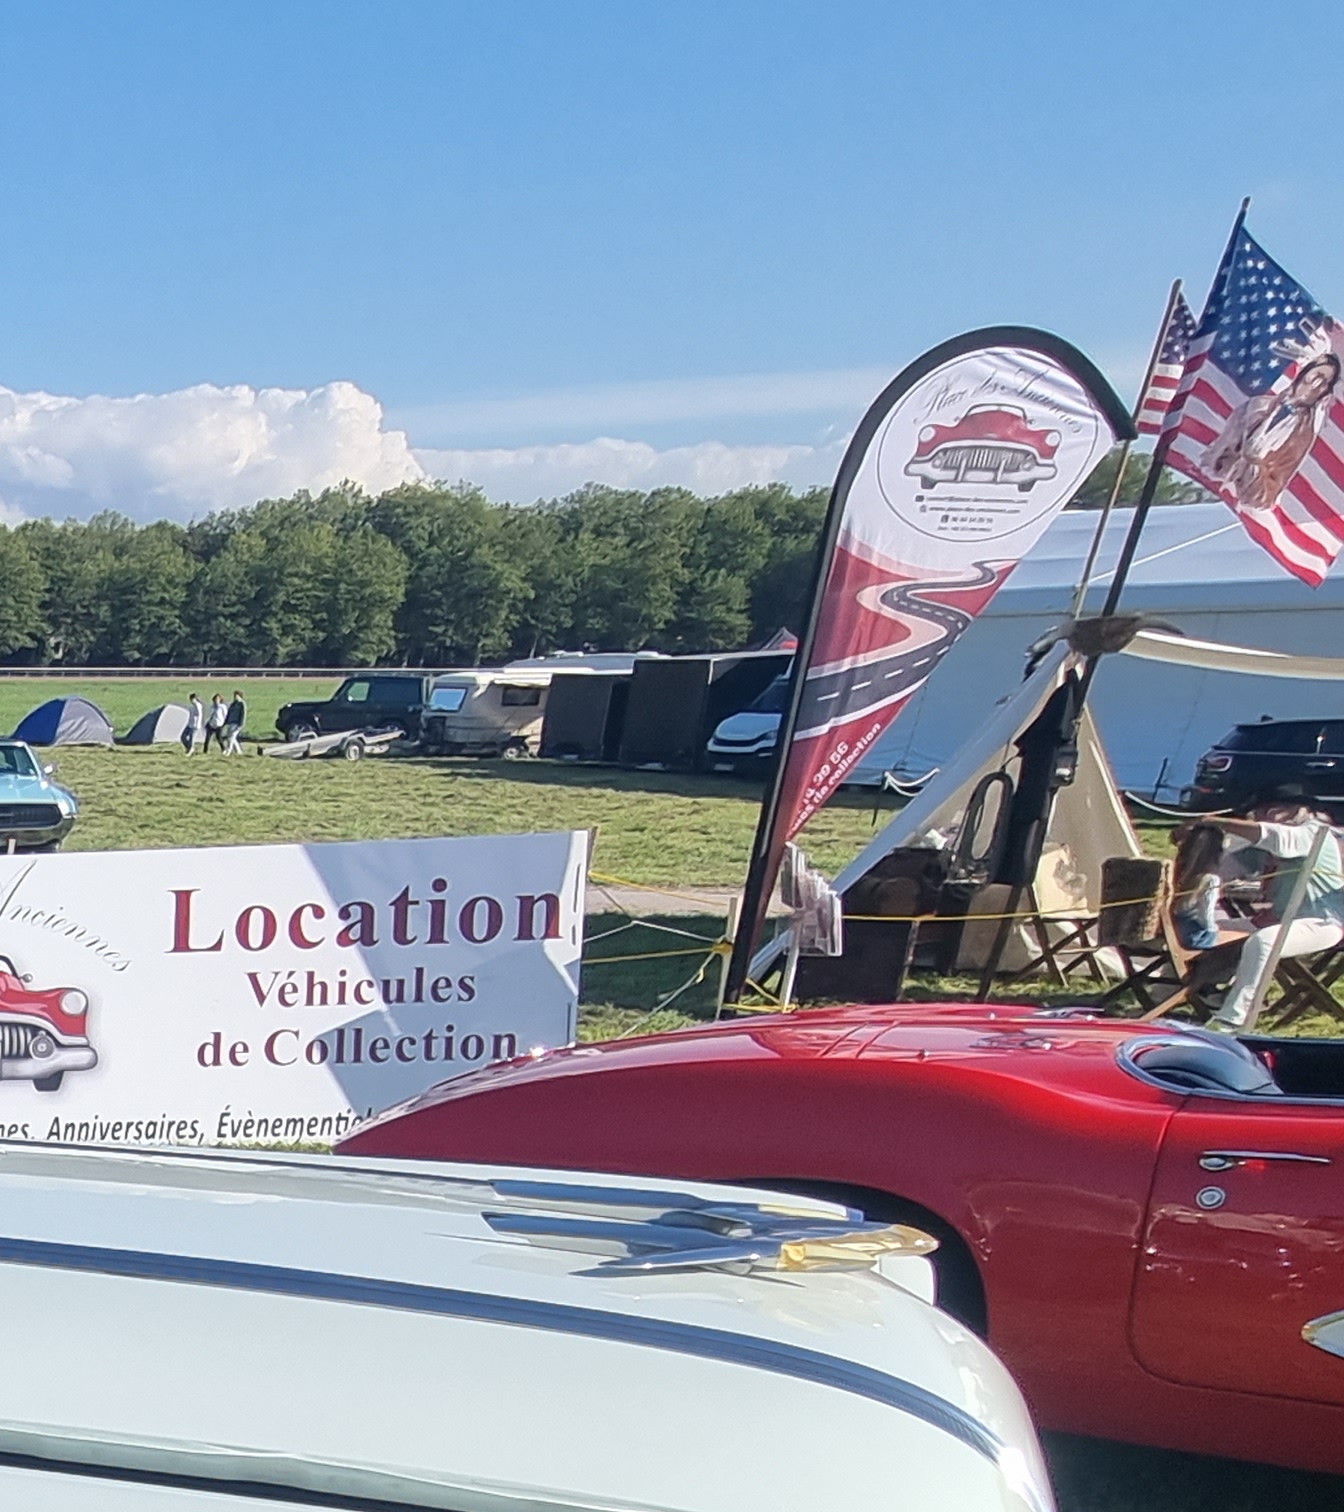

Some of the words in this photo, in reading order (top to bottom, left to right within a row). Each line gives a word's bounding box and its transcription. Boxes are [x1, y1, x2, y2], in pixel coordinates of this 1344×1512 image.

[829, 723, 881, 785] collection
[164, 877, 564, 954] Location
[246, 967, 477, 1008] Véhicules
[197, 1032, 250, 1067] de
[264, 1024, 517, 1066] Collection
